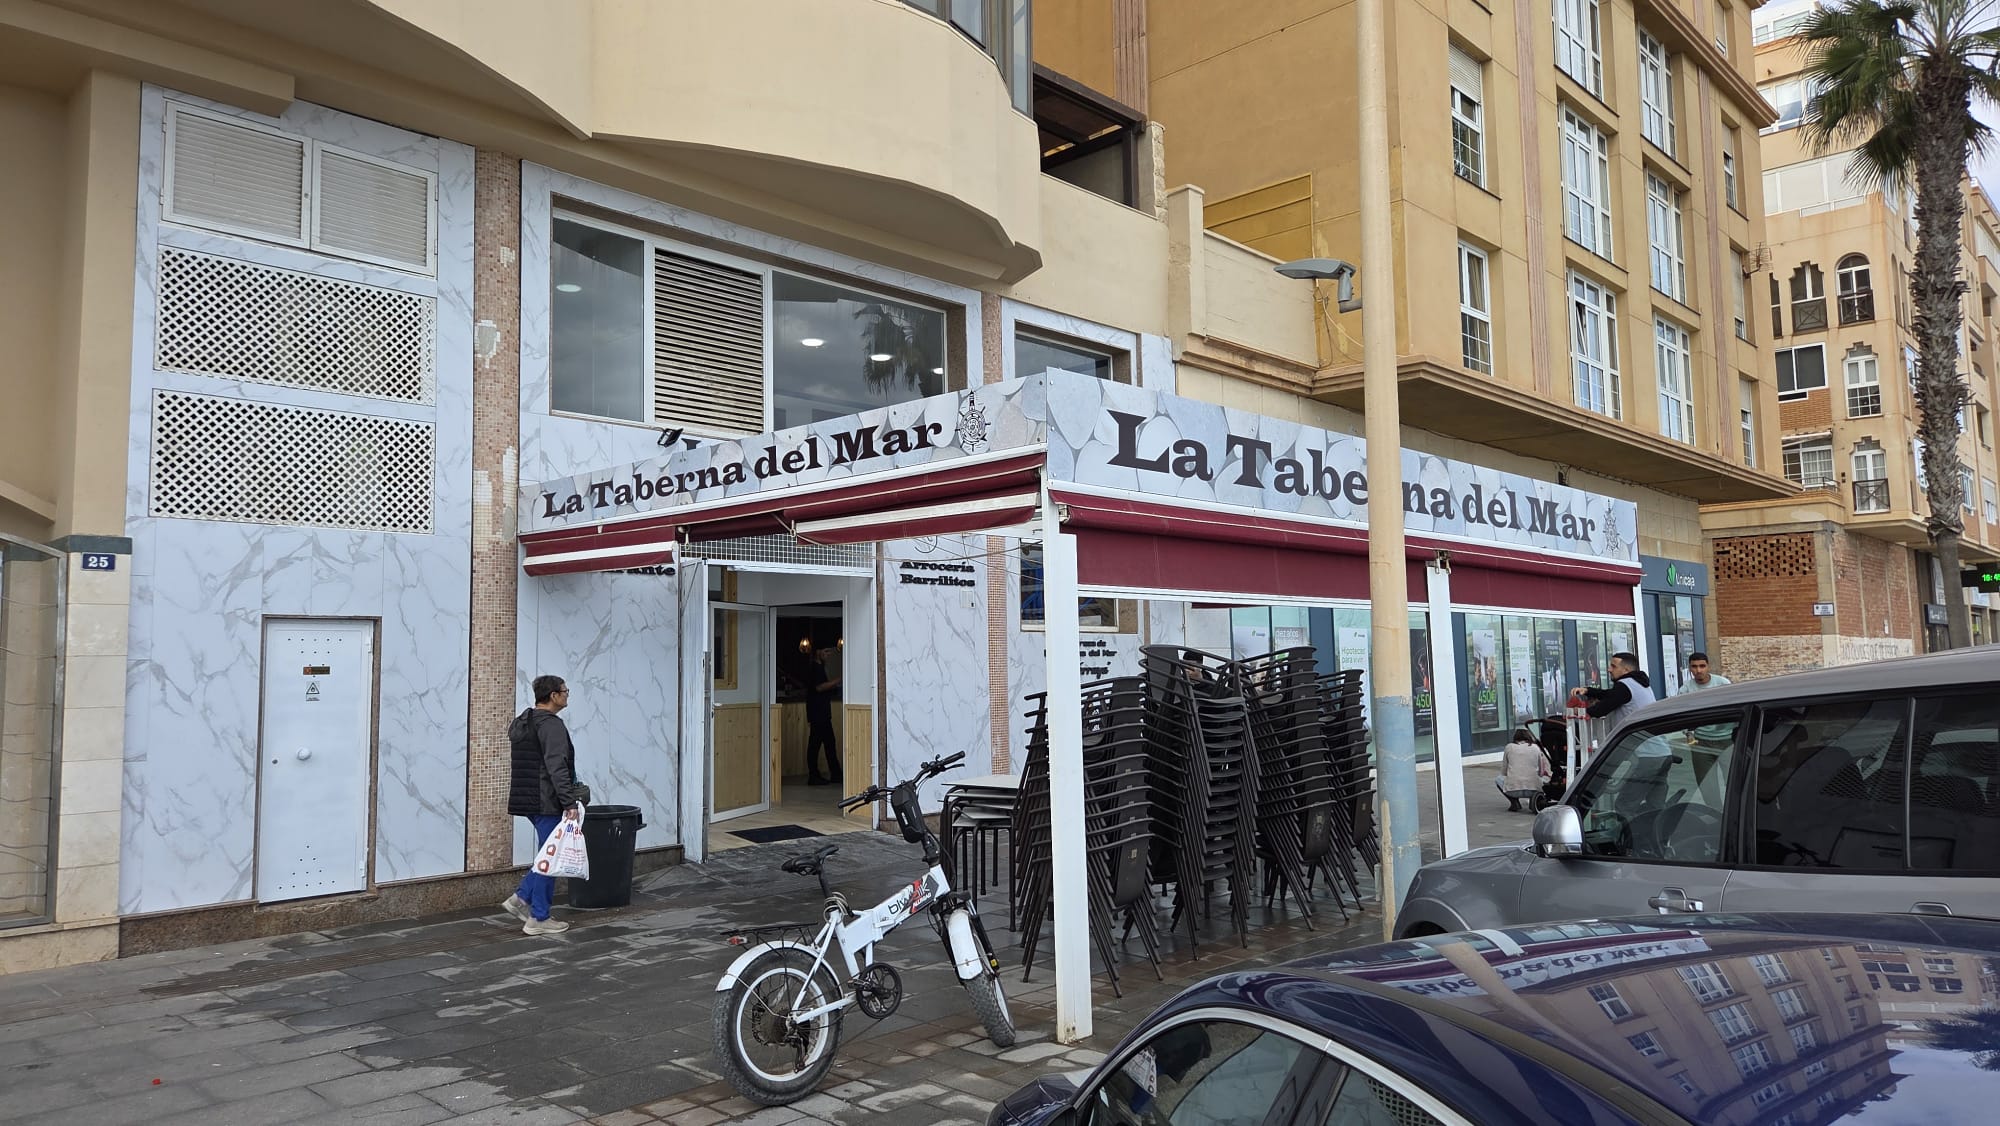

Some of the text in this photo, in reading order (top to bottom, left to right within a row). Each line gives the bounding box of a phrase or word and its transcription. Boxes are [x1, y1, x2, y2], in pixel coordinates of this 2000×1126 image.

[542, 422, 943, 519] La Taberna del Mar
[1107, 409, 1596, 542] La Tabena del Mar
[88, 556, 109, 568] 25
[900, 561, 975, 573] Arrocería
[899, 573, 976, 587] Barrilitos
[1675, 572, 1696, 591] Unicaja
[1415, 693, 1432, 709] 450
